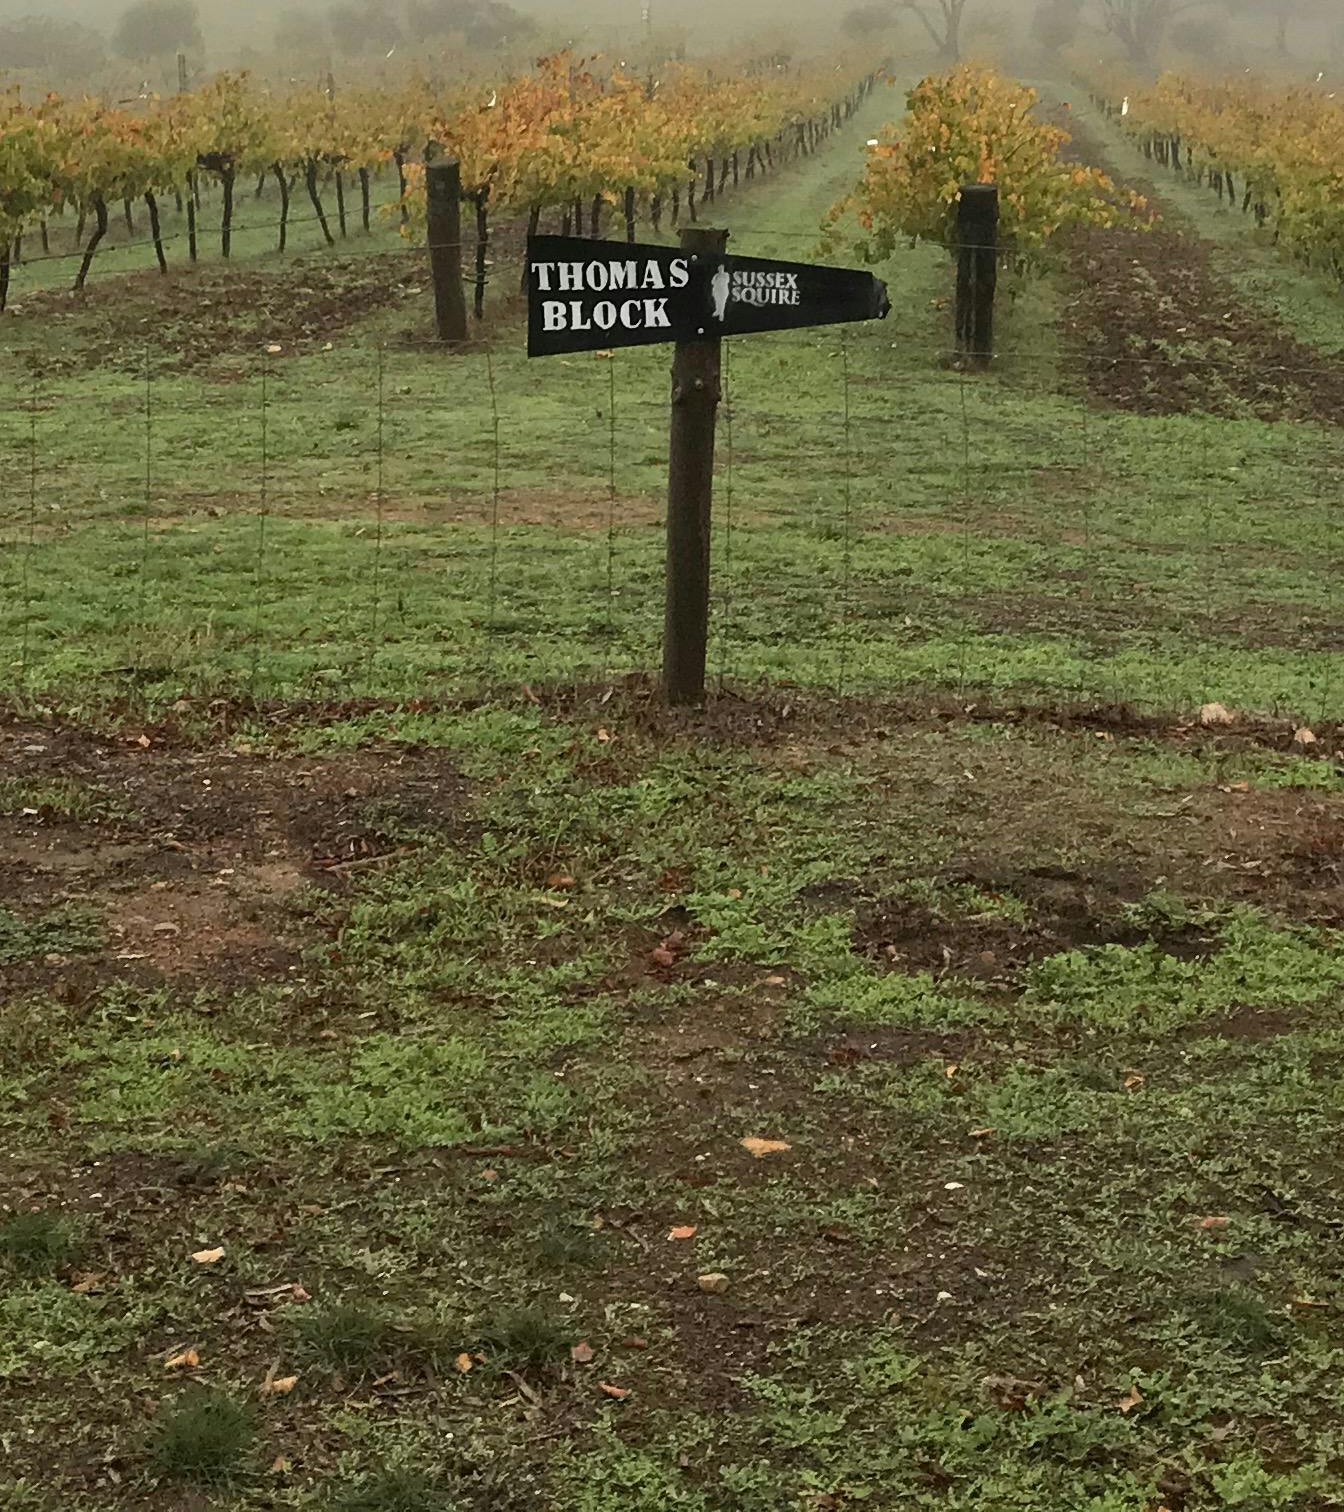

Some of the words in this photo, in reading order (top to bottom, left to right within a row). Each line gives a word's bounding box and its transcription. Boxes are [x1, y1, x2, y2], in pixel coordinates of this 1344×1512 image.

[531, 258, 689, 292] THOMAS
[732, 271, 798, 289] SUSSEX
[731, 287, 801, 307] SQUIRE
[542, 298, 672, 332] BLOCK
